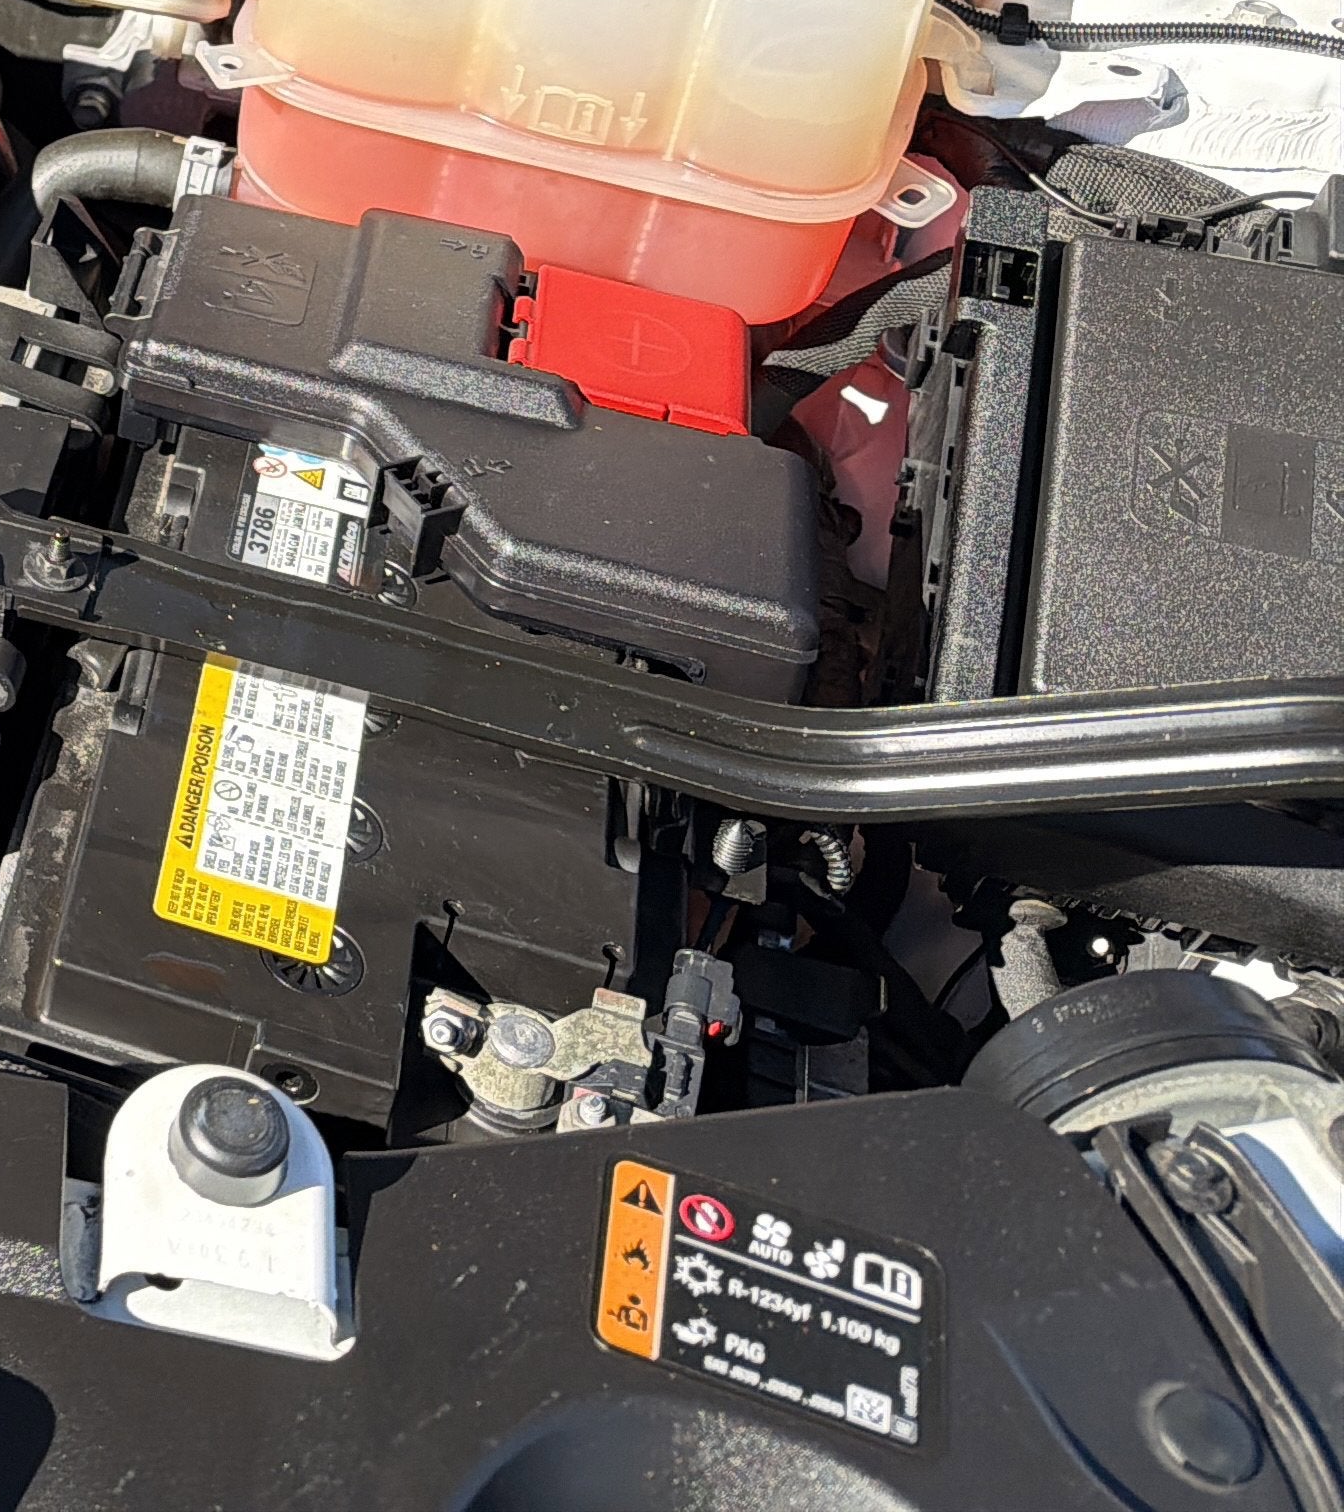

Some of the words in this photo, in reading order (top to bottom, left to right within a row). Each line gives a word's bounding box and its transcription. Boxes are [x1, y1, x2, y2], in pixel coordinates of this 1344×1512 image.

[248, 506, 275, 554] 3786
[336, 520, 359, 582] ACDelco
[184, 724, 217, 835] DANGER/POISON
[748, 1243, 793, 1266] AUTO
[727, 1278, 812, 1320] R-1234yf
[820, 1310, 872, 1342] 1.100
[873, 1331, 900, 1357] kg
[724, 1333, 766, 1364] PAG
